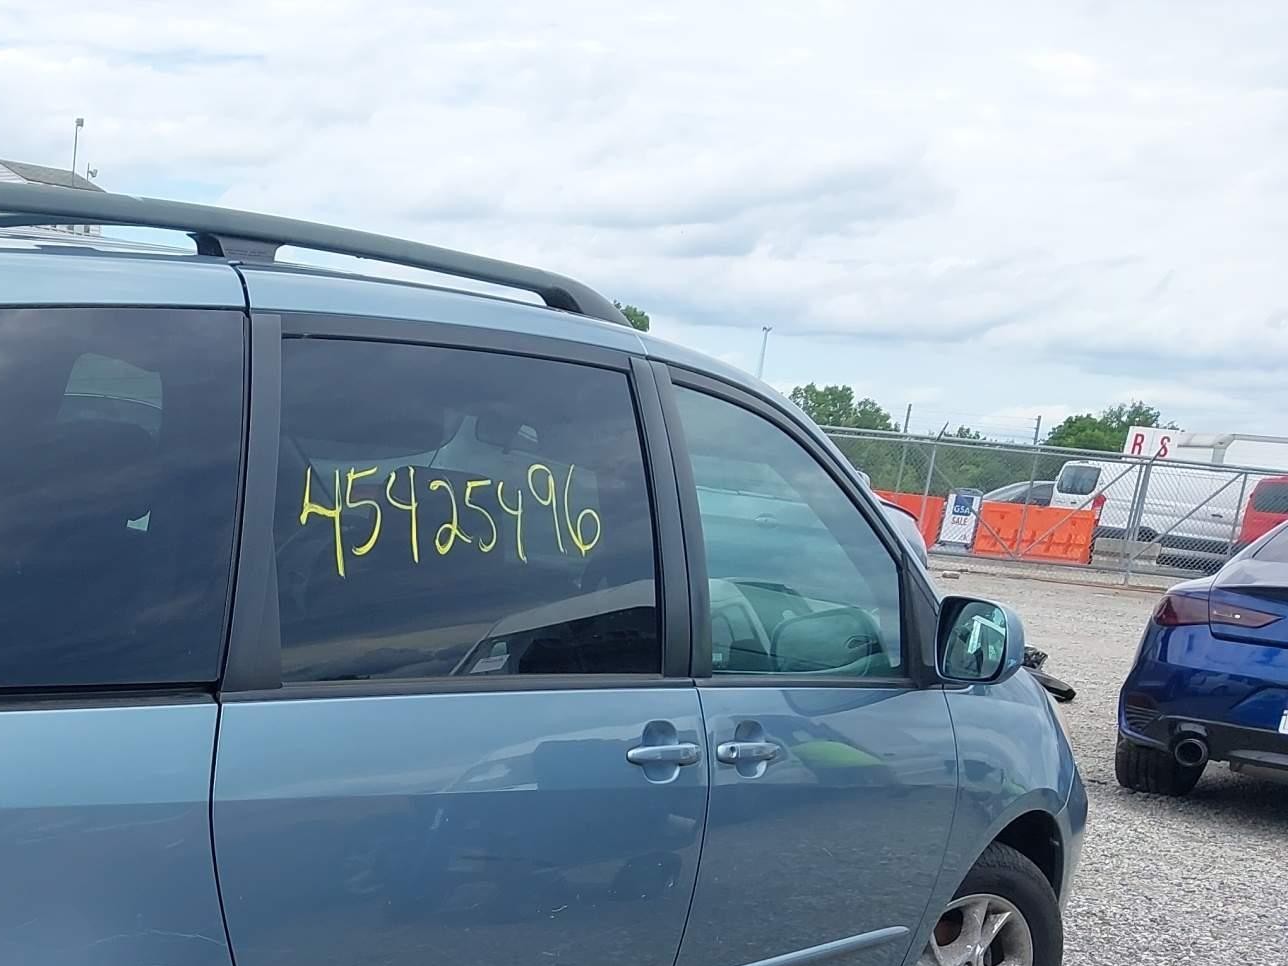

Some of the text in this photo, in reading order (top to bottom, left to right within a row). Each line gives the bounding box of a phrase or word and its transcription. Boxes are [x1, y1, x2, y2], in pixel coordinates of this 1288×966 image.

[1131, 433, 1144, 455] R
[953, 504, 970, 514] GSA
[300, 464, 601, 578] 45425496
[951, 516, 969, 525] SALE
